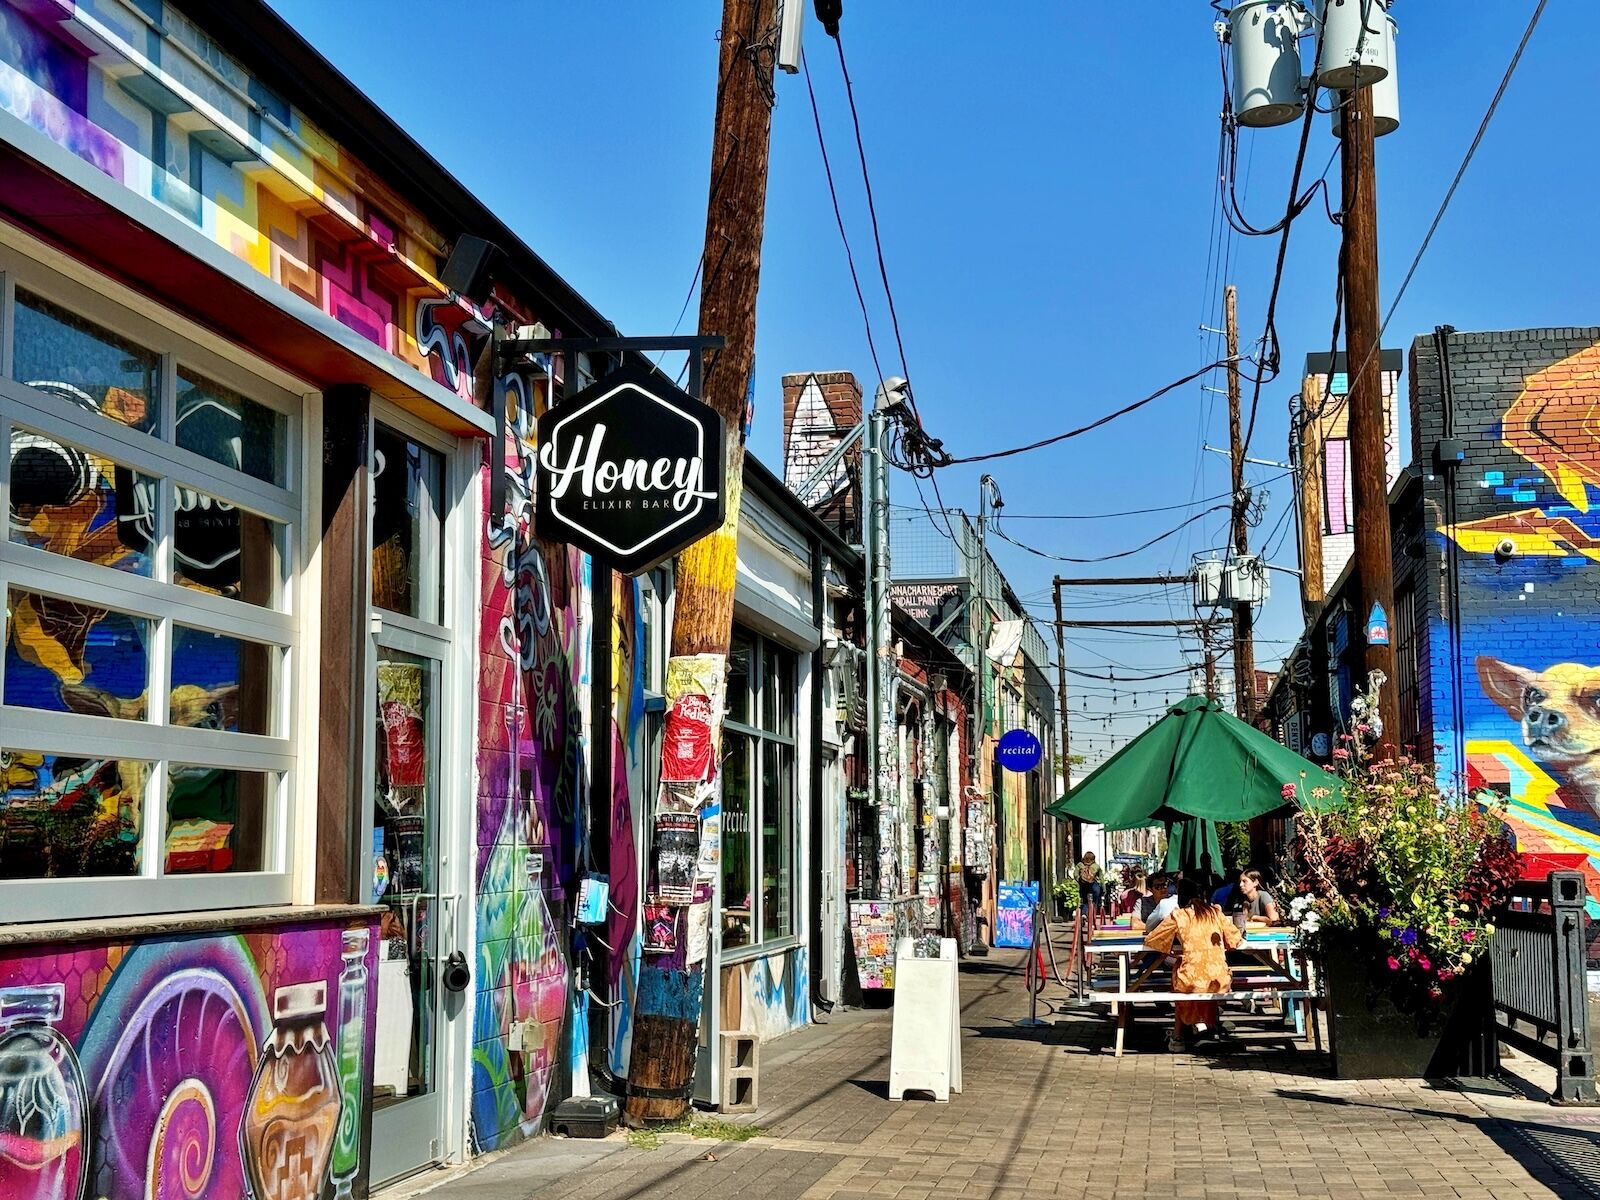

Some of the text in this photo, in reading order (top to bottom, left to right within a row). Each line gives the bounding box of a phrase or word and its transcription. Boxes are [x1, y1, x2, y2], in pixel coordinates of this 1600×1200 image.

[540, 423, 718, 511] Honey
[583, 499, 669, 510] ELIXIR BAR
[890, 585, 958, 597] NNACHARNEYART
[1291, 722, 1299, 751] DENVE
[1002, 743, 1036, 755] recital
[722, 802, 749, 833] recita
